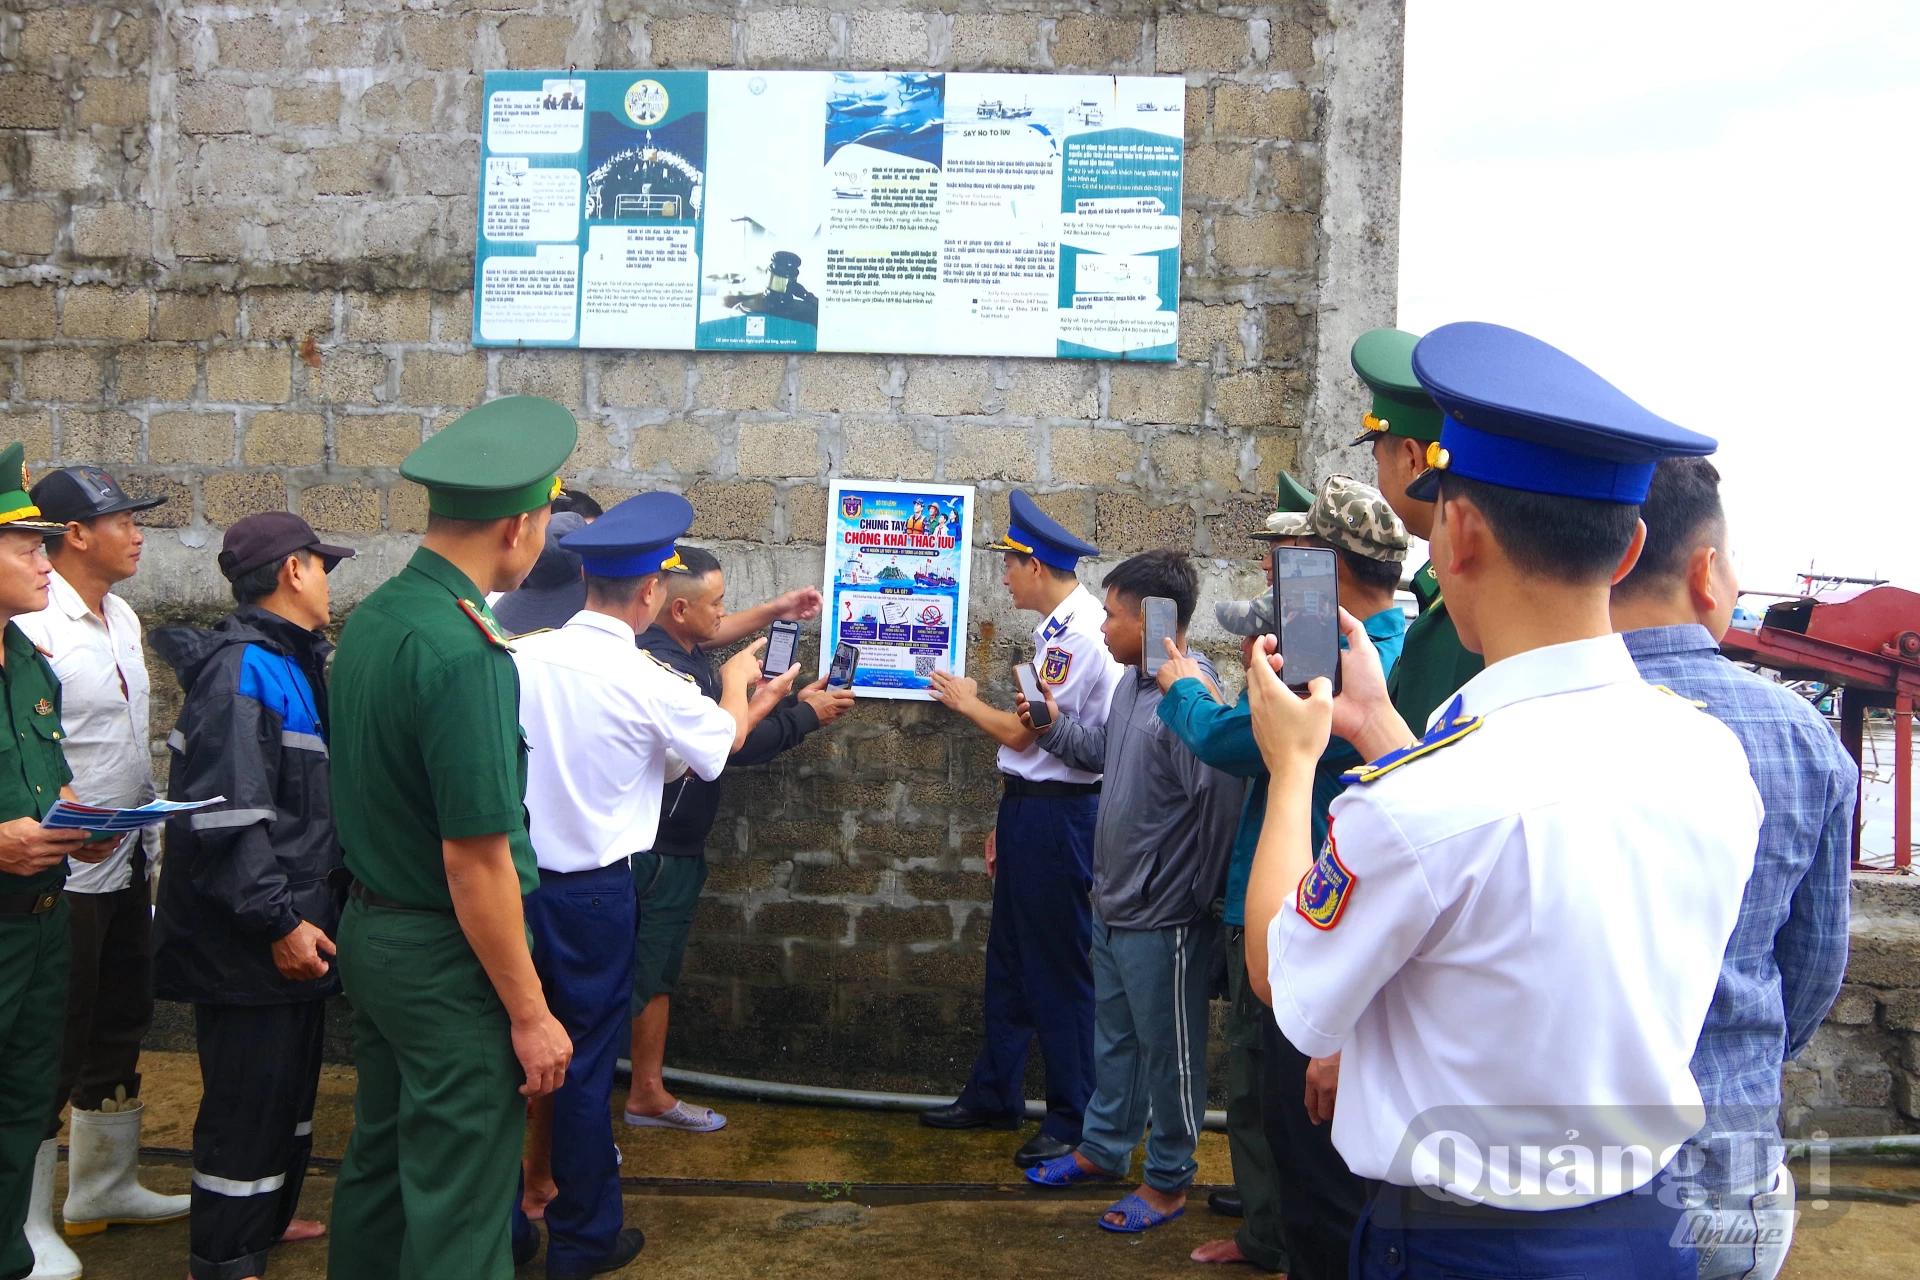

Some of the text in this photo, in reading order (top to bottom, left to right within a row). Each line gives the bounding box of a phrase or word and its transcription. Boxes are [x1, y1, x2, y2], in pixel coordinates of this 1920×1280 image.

[977, 129, 988, 137] NO
[860, 519, 906, 531] CHUNG TAY
[845, 530, 954, 549] CHỐNG KHAI THÁC IUU
[1323, 871, 1340, 888] GUARD
